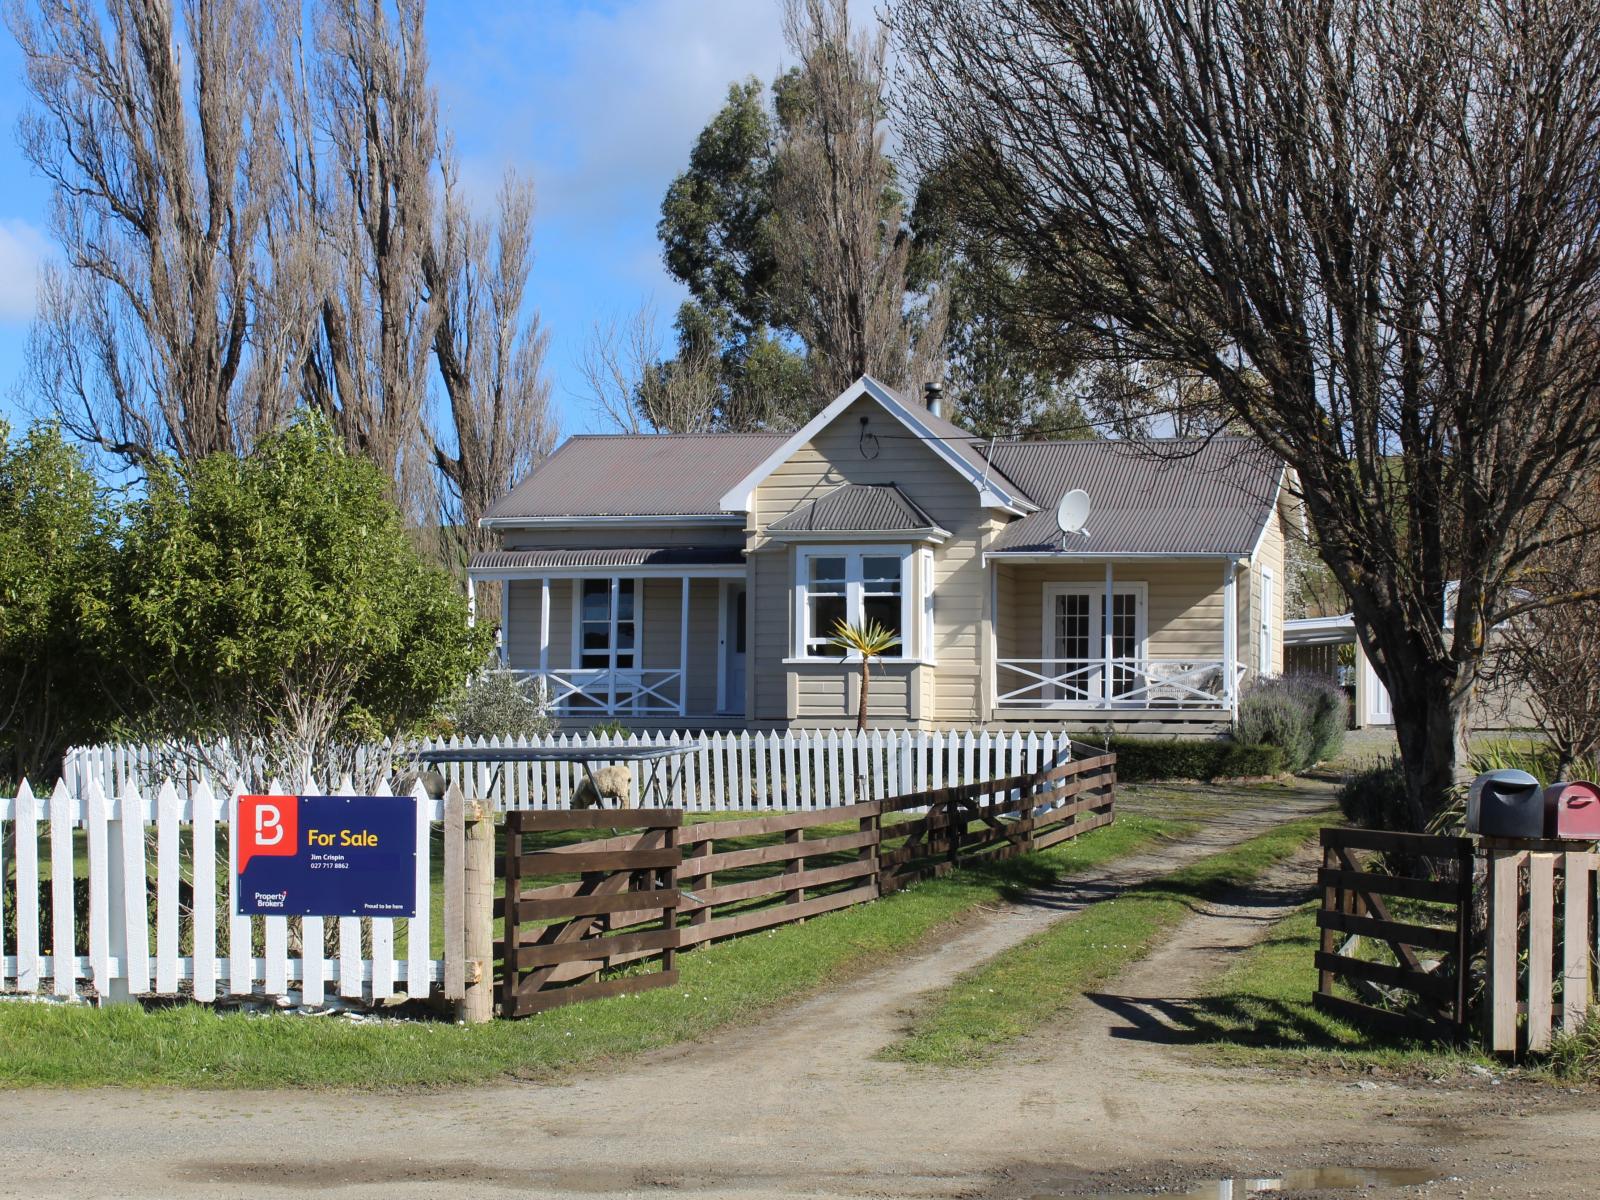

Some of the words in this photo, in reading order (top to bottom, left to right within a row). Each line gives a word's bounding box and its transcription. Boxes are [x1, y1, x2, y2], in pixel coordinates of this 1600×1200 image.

[308, 829, 336, 846] For
[340, 829, 378, 847] Sale
[255, 892, 286, 901] Property
